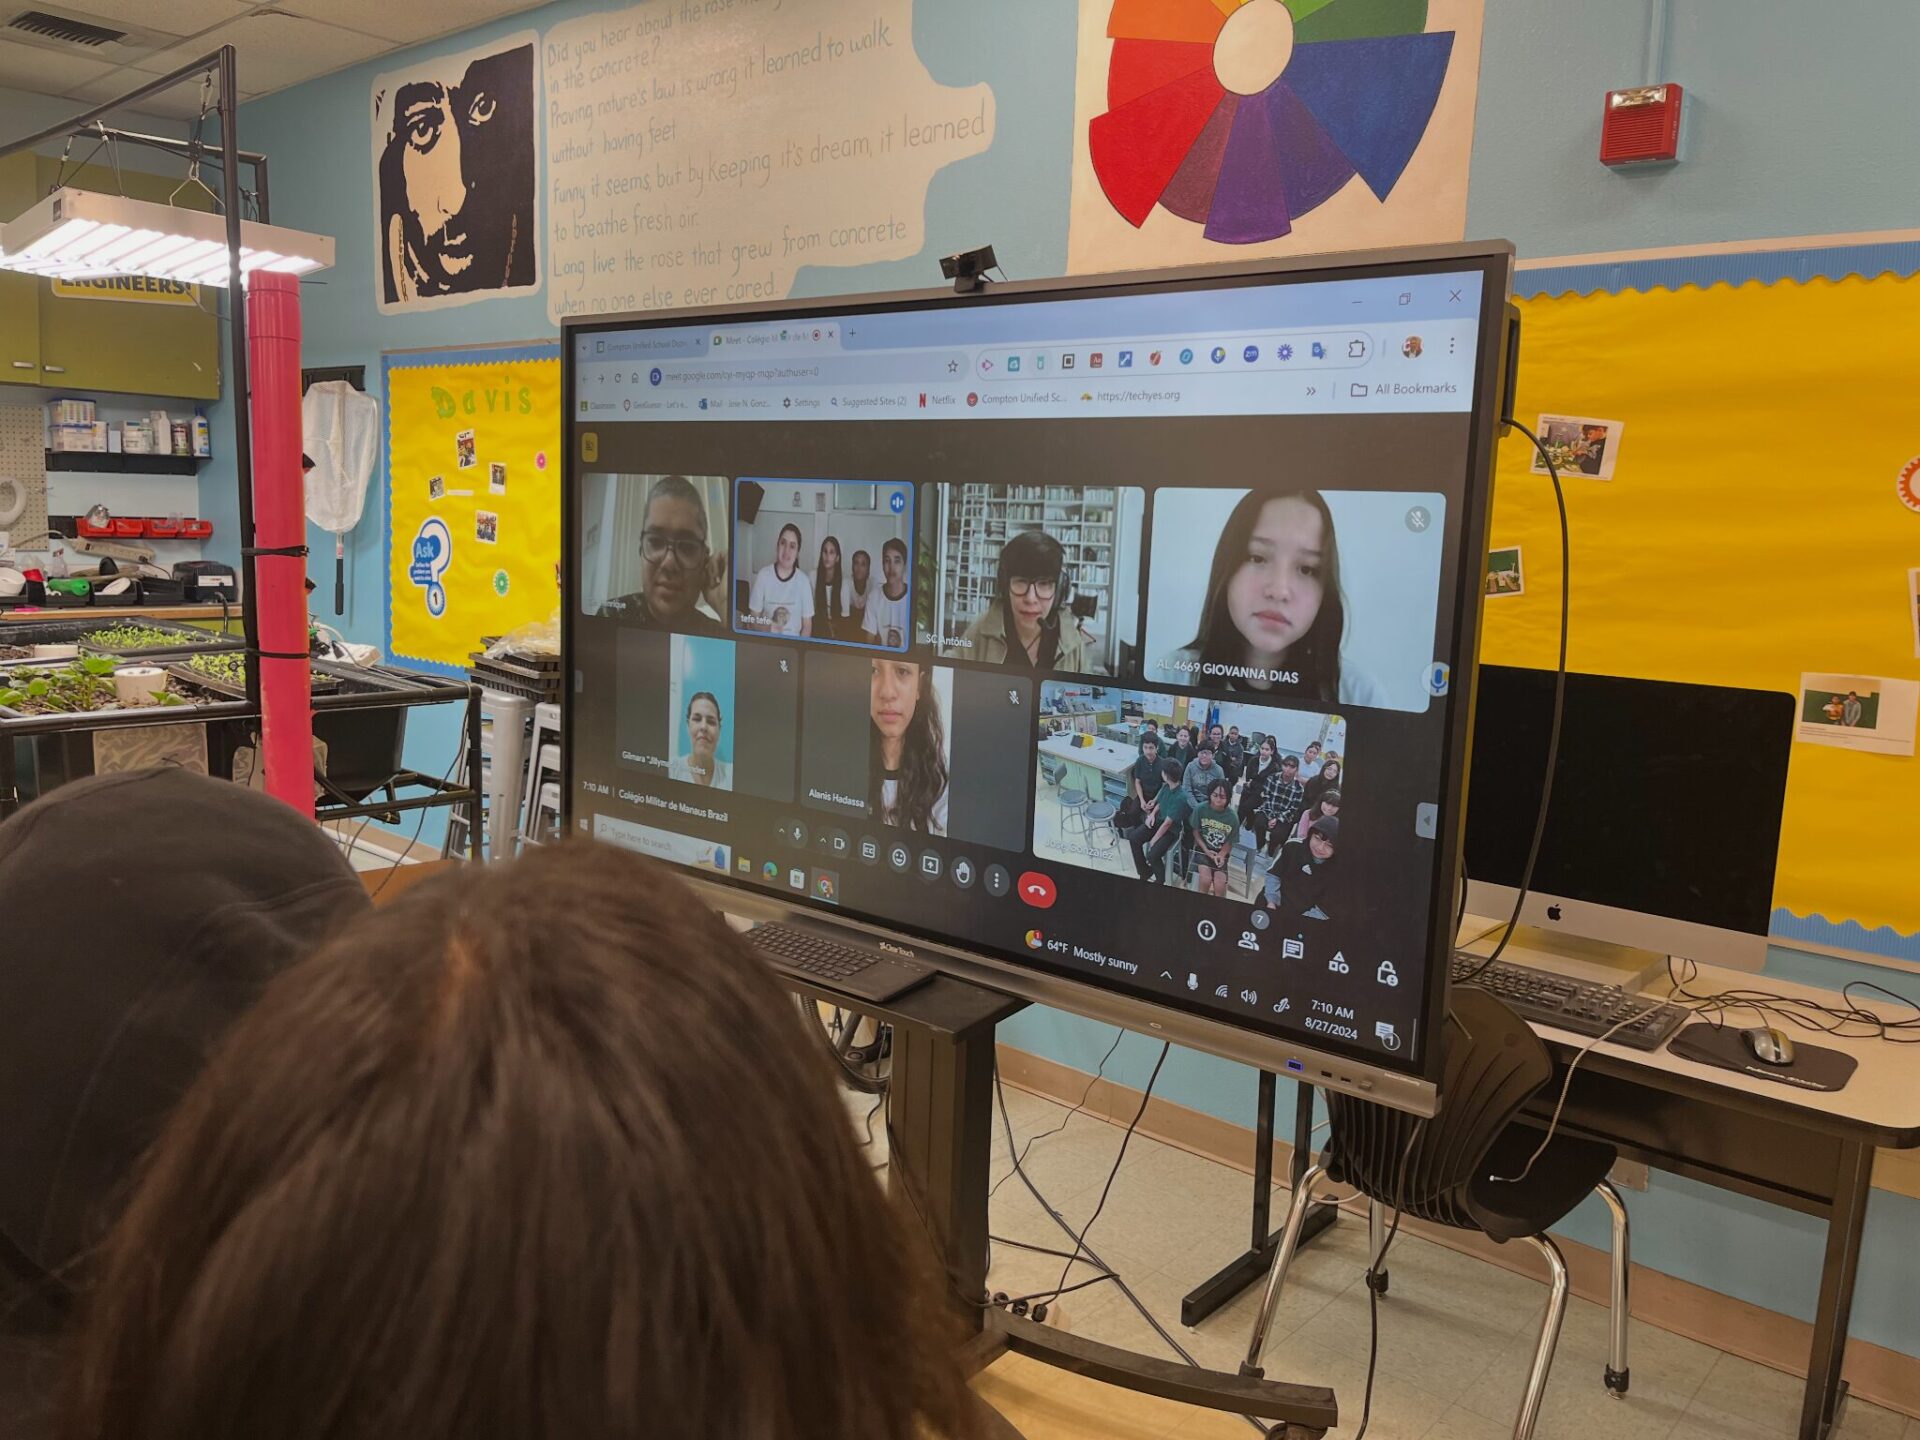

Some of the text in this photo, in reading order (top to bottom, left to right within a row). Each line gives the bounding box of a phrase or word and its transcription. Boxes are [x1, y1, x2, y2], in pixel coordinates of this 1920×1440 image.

[547, 42, 569, 69] Did
[575, 41, 597, 70] you
[601, 27, 631, 48] hear
[636, 12, 673, 37] about
[680, 0, 701, 25] the
[704, 0, 734, 14] rose
[550, 36, 661, 96] in the concrete?
[551, 16, 893, 132] Proving nature's law is wrong it learned to walk
[552, 116, 677, 164] without having feet
[591, 173, 601, 198] it
[606, 174, 652, 197] seems,
[656, 162, 682, 189] but
[688, 152, 704, 199] by
[708, 150, 771, 189] keeping
[781, 139, 804, 169] it's
[810, 134, 873, 163] dream,
[880, 125, 894, 153] it
[903, 97, 986, 148] learned
[554, 202, 699, 242] to breathe fresh air.
[553, 214, 907, 292] Long live the rose that grew from concrete
[554, 271, 778, 316] when no one else ever cared.
[431, 375, 533, 419] Davis
[932, 395, 956, 405] Netflix
[982, 393, 1019, 404] Compton
[1020, 392, 1049, 404] Unified
[1097, 390, 1181, 403] https://techyes.org
[1375, 382, 1457, 395] All Bookmarks
[794, 399, 820, 409] Settings
[842, 397, 878, 409] Suggested
[415, 541, 435, 558] Ask
[740, 614, 755, 624] tefe
[1173, 659, 1201, 673] 4669
[1202, 662, 1267, 682] GIOVANNA
[1269, 669, 1300, 684] DIAS
[583, 781, 609, 795] 7:10 AM
[808, 788, 865, 809] Alanis Hadassa
[618, 789, 729, 823] Colégio Militar de Manaus Brazil
[1047, 939, 1139, 975] 64°F Mostly sunny
[1311, 999, 1355, 1020] 7:10 AM
[1304, 1016, 1358, 1041] 8/27/2024
